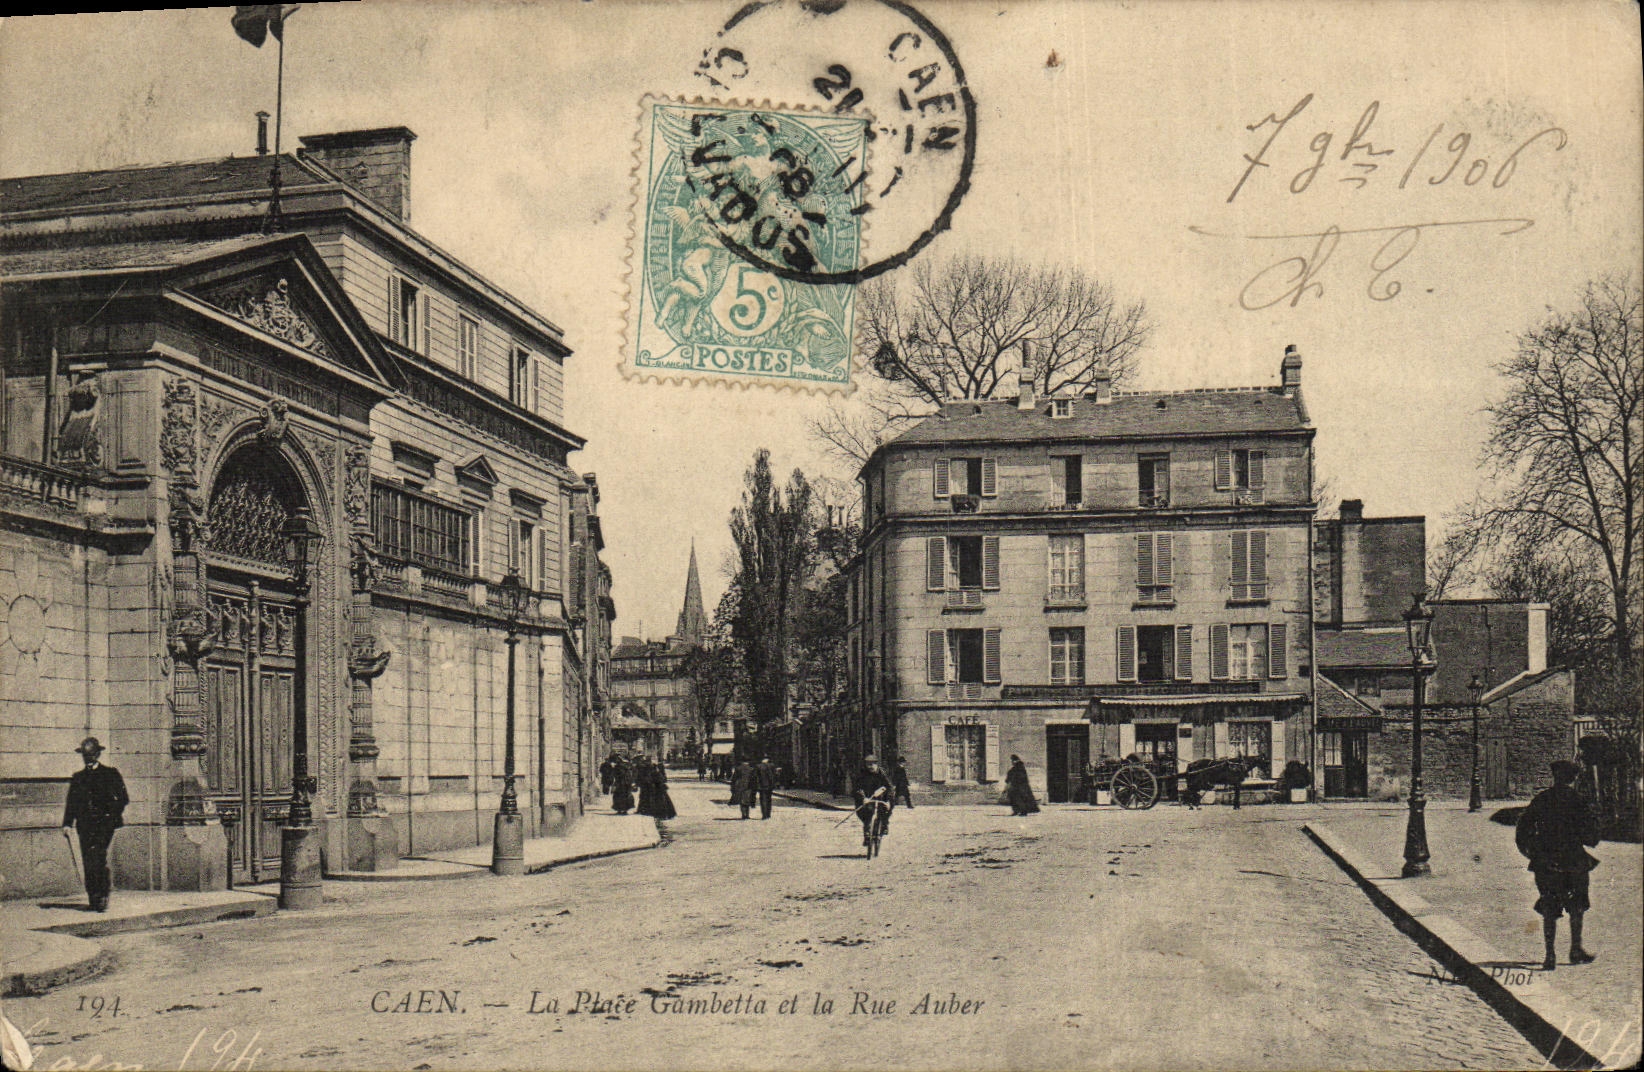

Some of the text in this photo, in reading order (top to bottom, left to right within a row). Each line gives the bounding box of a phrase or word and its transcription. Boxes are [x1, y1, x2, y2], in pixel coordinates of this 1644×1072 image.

[888, 32, 958, 152] CAEN
[1226, 93, 1314, 203] 7
[1399, 123, 1569, 189] 1906
[694, 346, 790, 374] POSTES
